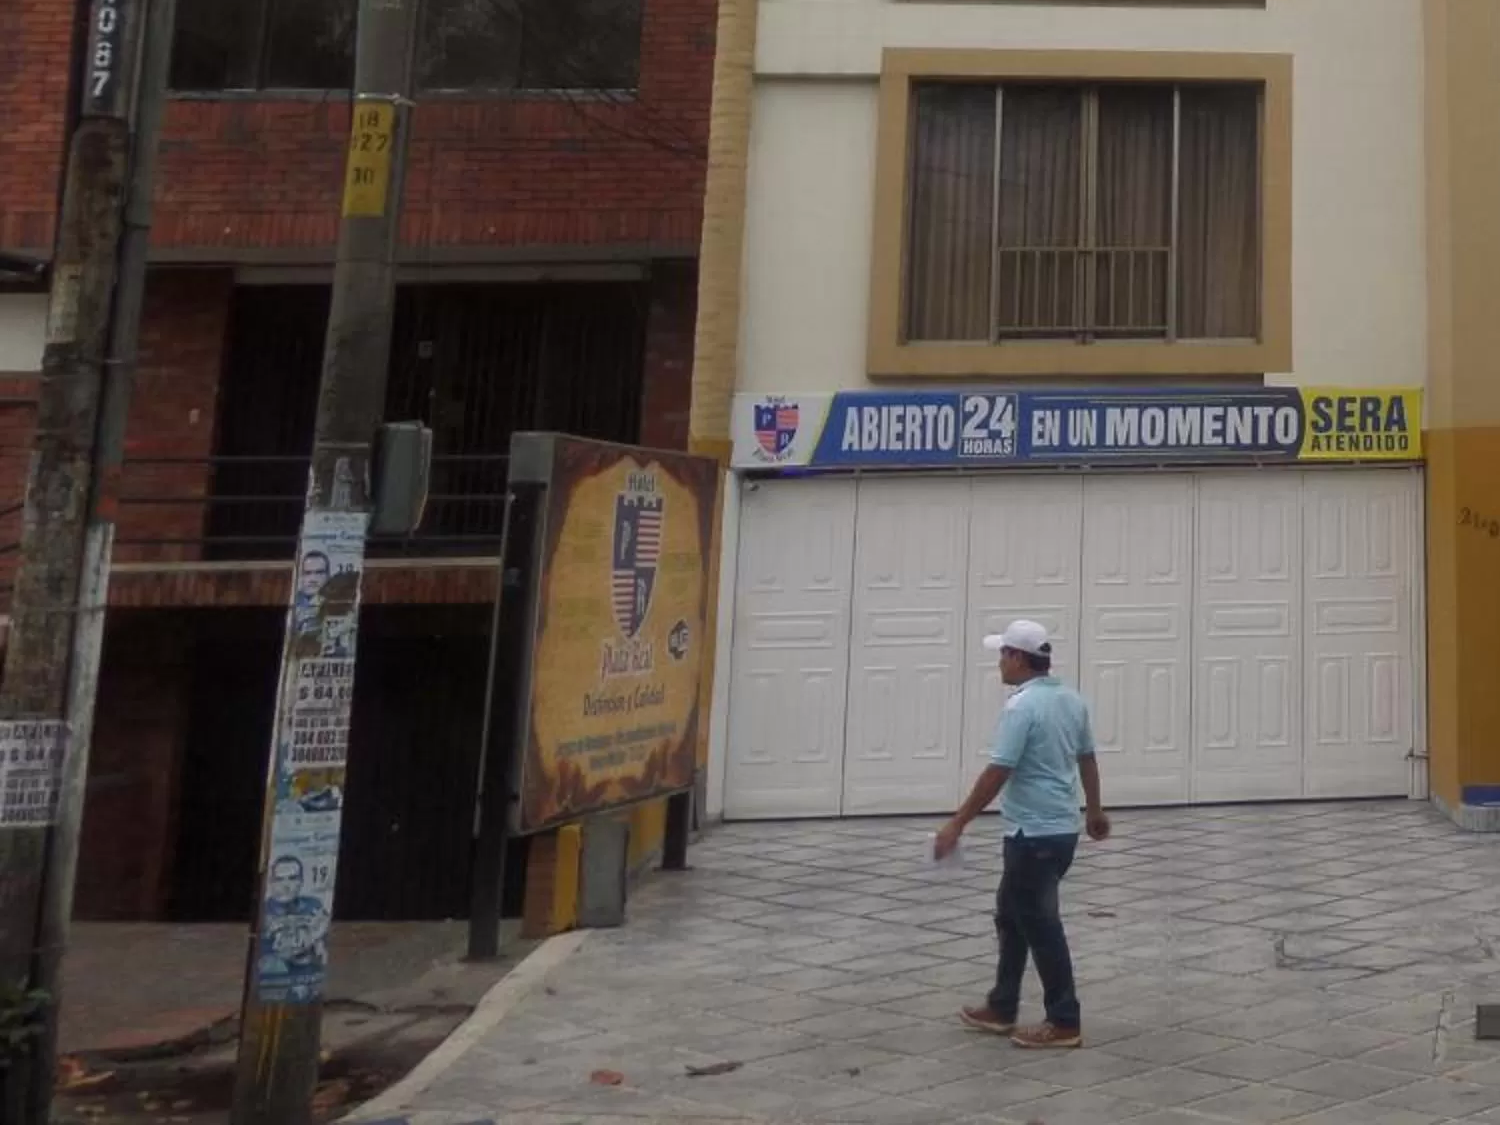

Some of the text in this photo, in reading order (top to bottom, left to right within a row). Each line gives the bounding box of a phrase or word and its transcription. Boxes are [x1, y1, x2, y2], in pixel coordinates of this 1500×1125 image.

[841, 405, 955, 452] ABIERTO
[962, 396, 1015, 438] 24
[1032, 406, 1298, 446] EN UN MOMENTO
[1311, 395, 1408, 433] SERA
[963, 438, 1012, 454] HORAS
[1311, 435, 1408, 452] ATENDIDO
